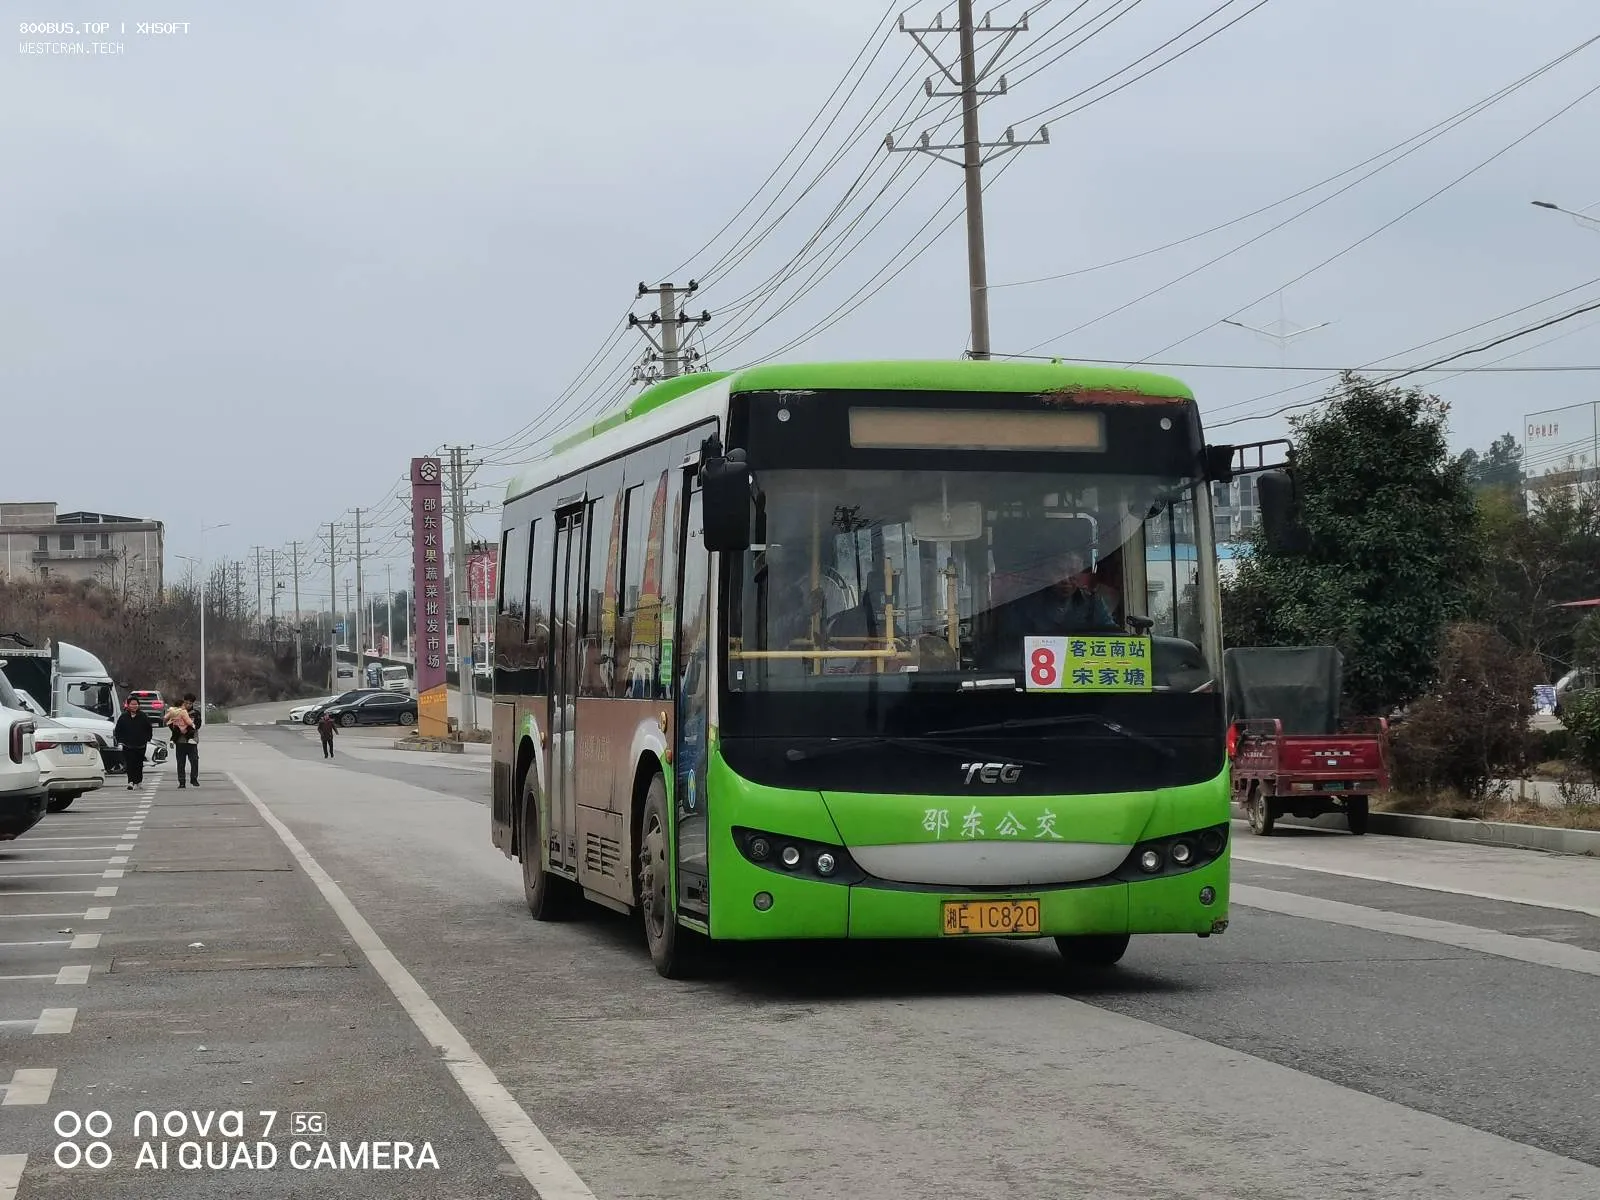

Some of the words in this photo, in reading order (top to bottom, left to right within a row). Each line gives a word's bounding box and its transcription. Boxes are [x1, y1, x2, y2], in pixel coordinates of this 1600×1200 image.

[424, 498, 440, 669] 邵东水果蔬菜批发市场
[1070, 640, 1145, 658] 客运南站
[1031, 648, 1056, 685] 8
[1072, 668, 1145, 685] 宋家塘
[960, 762, 1023, 785] TEG
[922, 805, 1064, 839] 邵东公交
